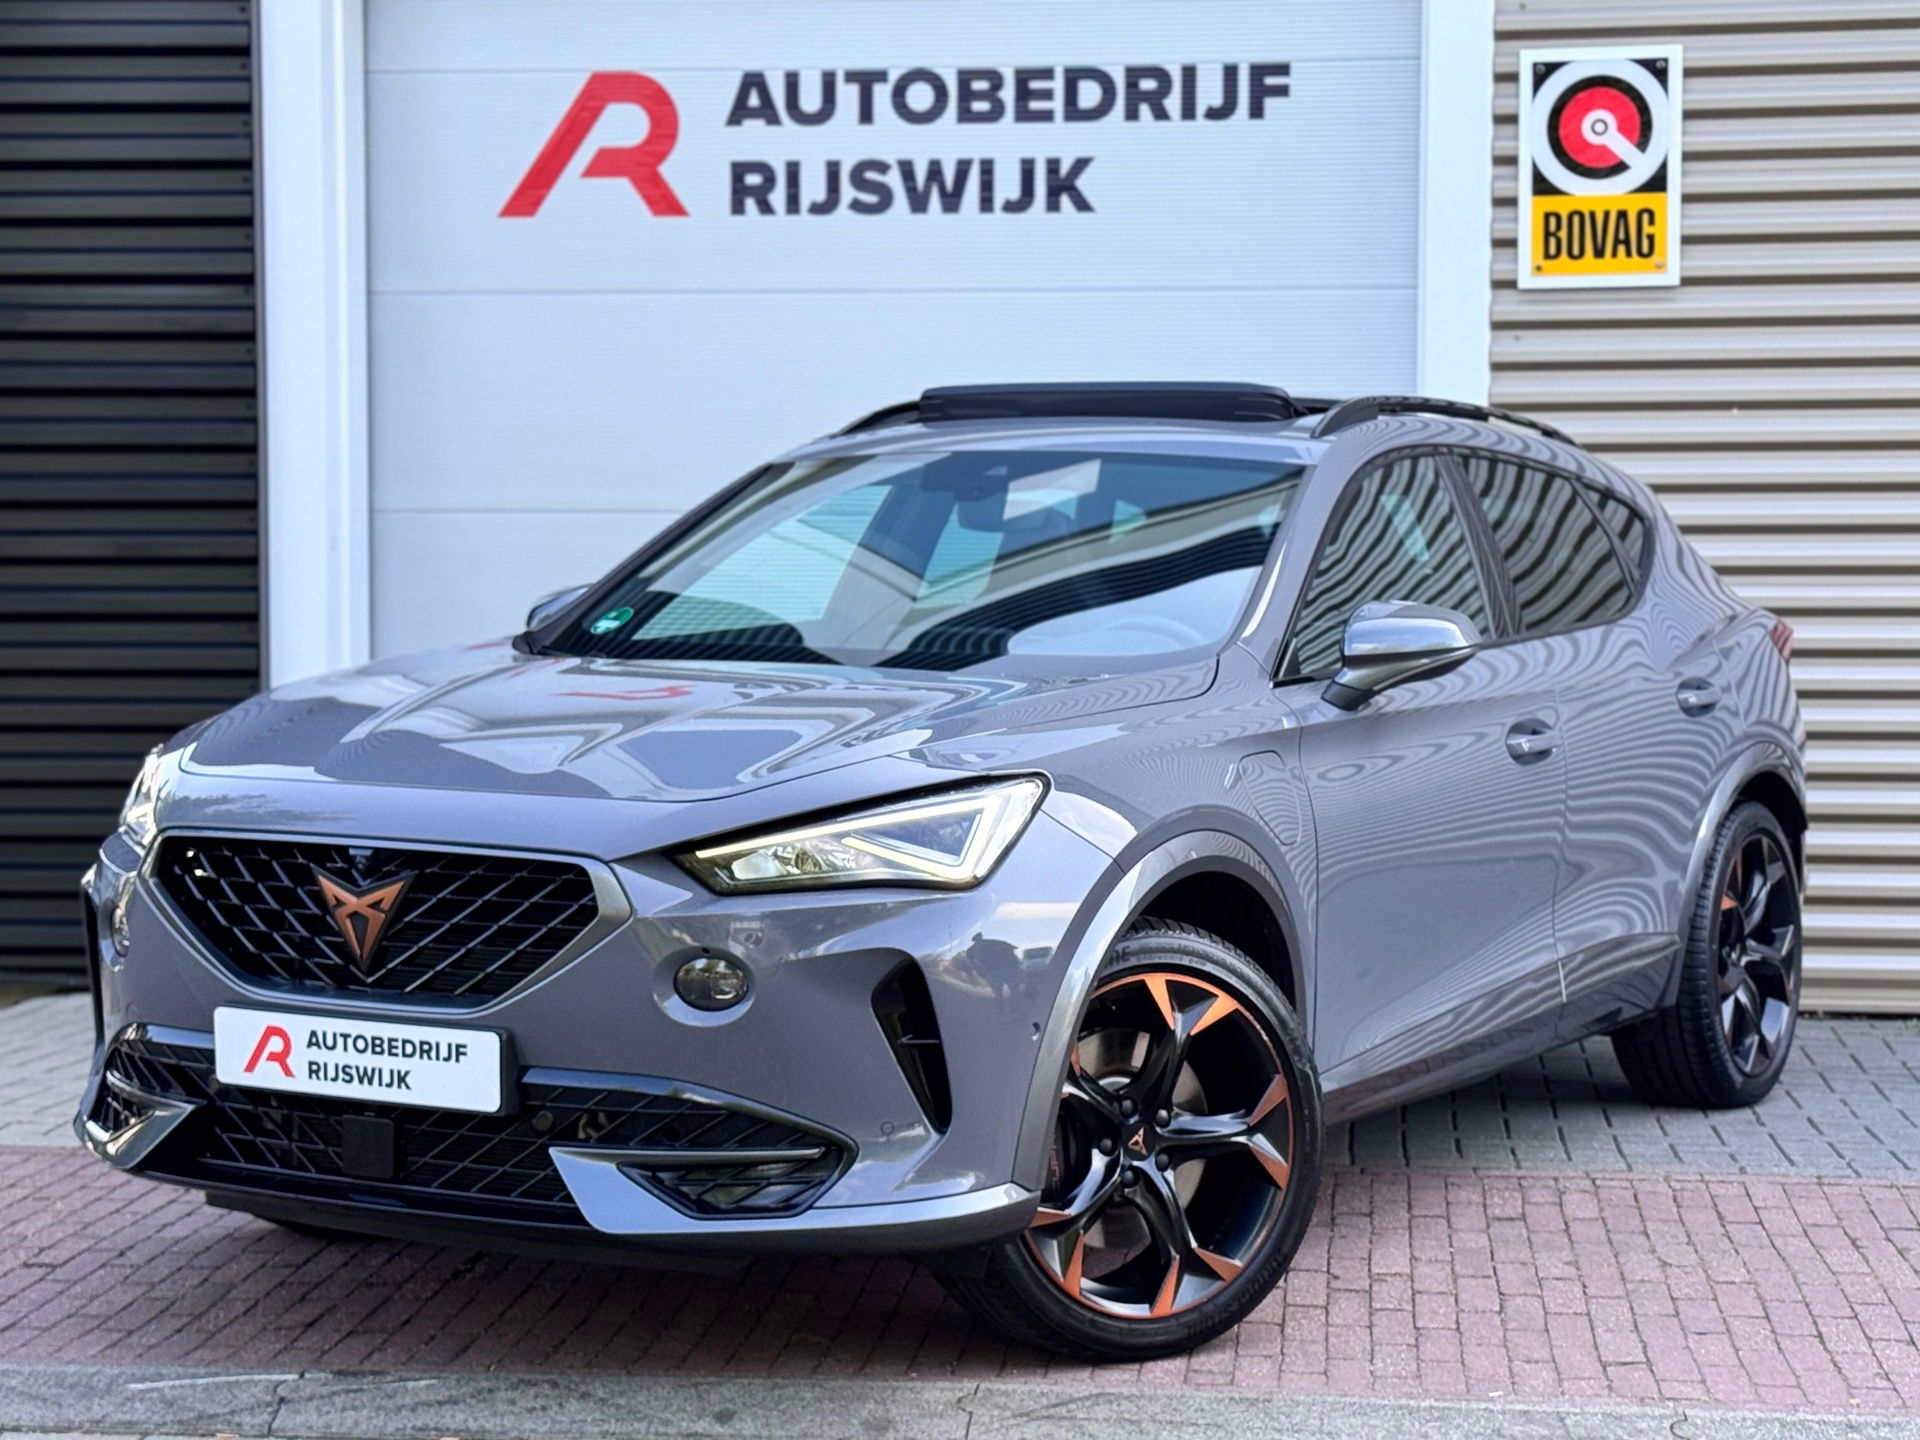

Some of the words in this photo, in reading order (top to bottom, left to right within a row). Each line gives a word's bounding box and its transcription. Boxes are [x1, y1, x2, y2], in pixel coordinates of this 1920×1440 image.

[725, 62, 1292, 127] AUTOBEDRIJF
[729, 157, 1095, 217] RIJSWIJK
[1543, 208, 1655, 260] BOVAG
[306, 1030, 468, 1063] AUTOBEDRIJF
[308, 1061, 412, 1090] RIJSWIJK
